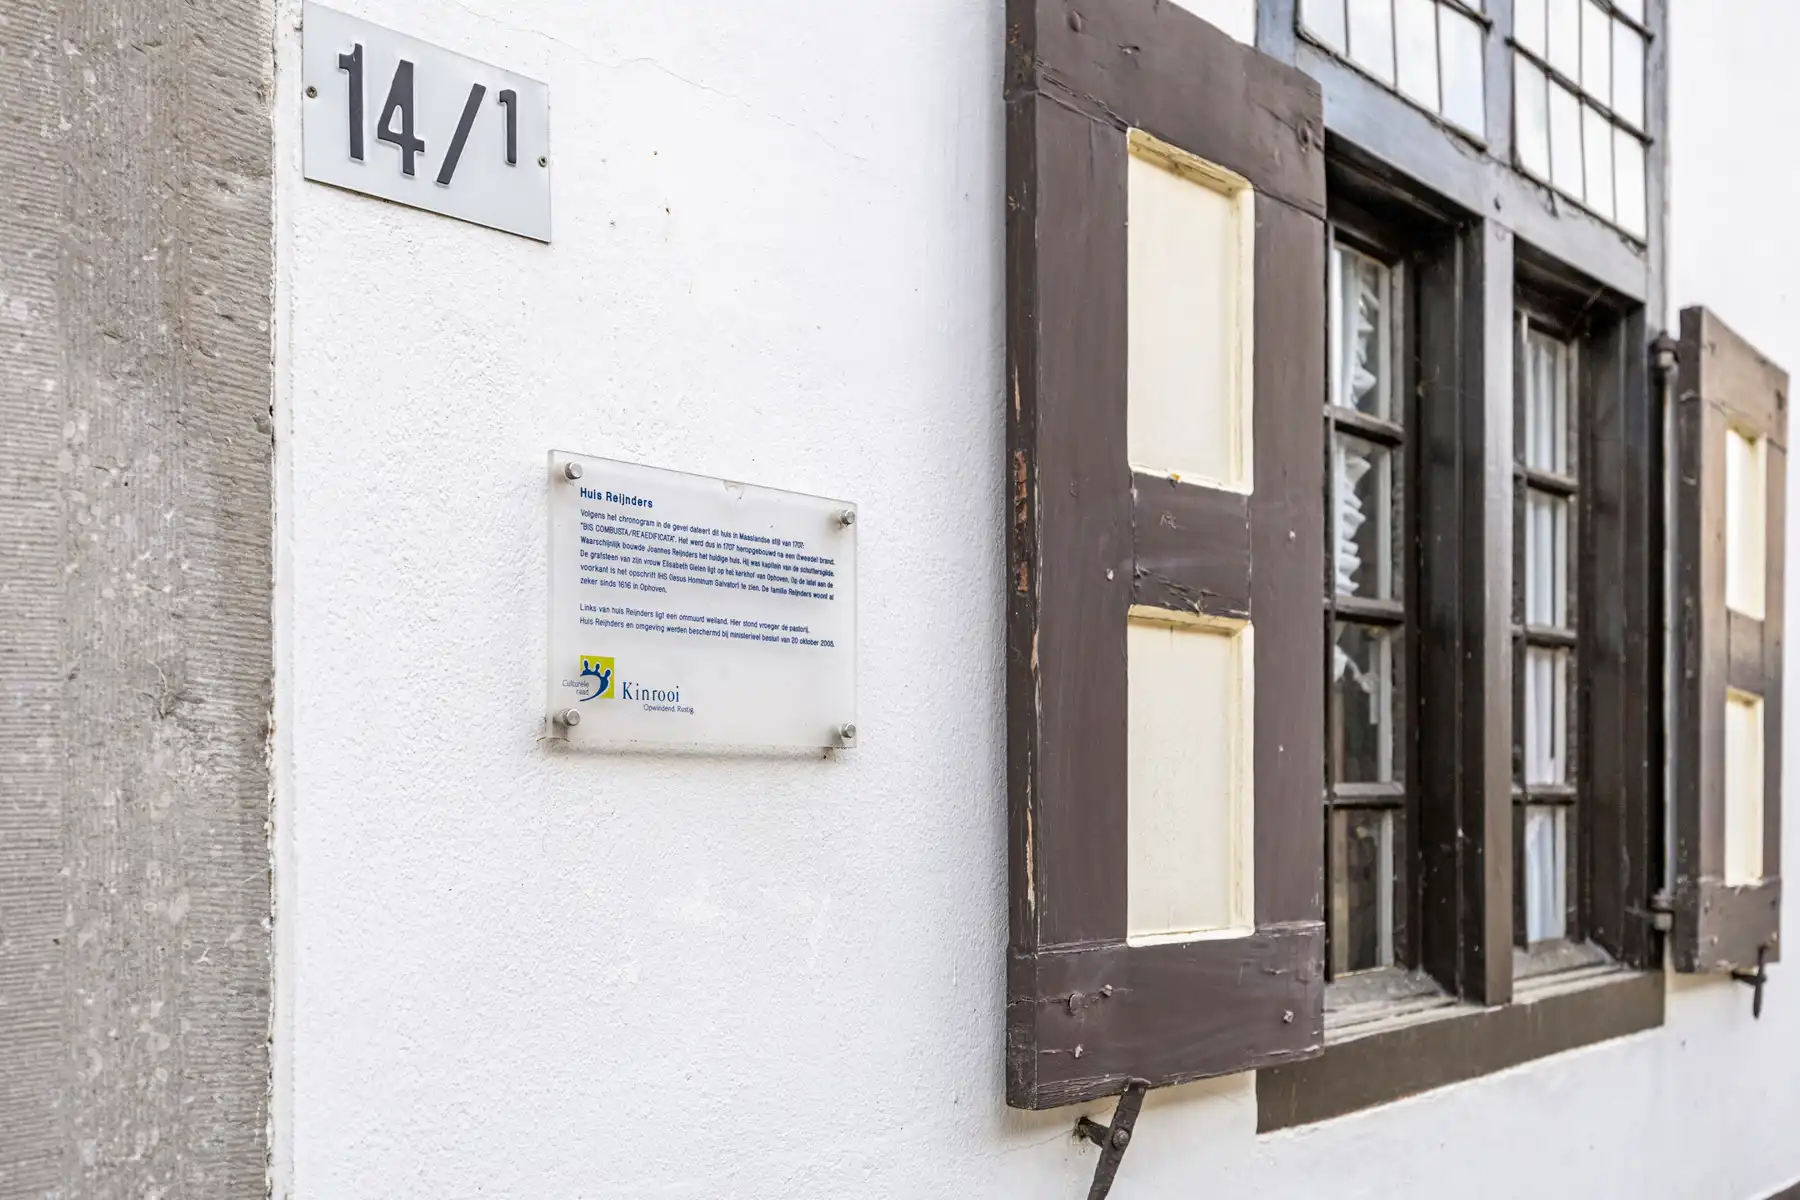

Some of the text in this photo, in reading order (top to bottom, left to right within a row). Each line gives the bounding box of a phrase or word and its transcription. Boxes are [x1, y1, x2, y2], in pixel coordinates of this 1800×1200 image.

[338, 42, 517, 185] 14/1
[580, 486, 653, 508] Huis Reijnders
[580, 508, 605, 520] Volgens
[607, 513, 617, 521] het
[618, 515, 655, 527] chronogram
[656, 520, 662, 528] in
[663, 521, 671, 529] de
[672, 524, 688, 532] gevel
[690, 526, 710, 535] dateert
[720, 530, 732, 538] huis
[739, 532, 770, 544] Maaslandse
[580, 536, 621, 549] Waarschijnlijk
[622, 541, 646, 552] bouwde
[647, 545, 671, 555] Joannes
[672, 548, 698, 559] Reijnders
[699, 552, 708, 560] het
[709, 553, 728, 564] huidige
[729, 556, 741, 564] huis.
[742, 557, 750, 566] Hij
[761, 561, 781, 570] kapitein
[678, 536, 688, 545] Het
[705, 540, 715, 549] dus
[723, 542, 735, 551] 1707
[736, 545, 776, 557] heropgebouwd
[580, 549, 588, 558] De
[590, 551, 619, 561] grafsteen
[632, 556, 642, 564] zijn
[662, 559, 688, 570] Elisabeth
[707, 565, 716, 575] ligt
[725, 568, 734, 576] het
[735, 569, 755, 578] kerkhof
[791, 576, 798, 585] Op
[798, 577, 805, 585] de
[827, 581, 834, 589] de
[580, 564, 608, 573] voorkant
[610, 566, 616, 574] is
[629, 570, 656, 579] opschrift
[657, 572, 668, 580] IHS
[688, 576, 714, 586] Hominum
[741, 582, 747, 590] te
[788, 588, 812, 598] Reijnders
[580, 577, 598, 585] zeker
[600, 579, 616, 588] sinds
[618, 580, 631, 589] 1616
[633, 582, 638, 590] in
[580, 603, 597, 612] Links
[612, 607, 624, 615] huis
[626, 607, 654, 618] Reijnders
[655, 611, 665, 620] ligt
[679, 614, 705, 623] ommuurd
[730, 618, 741, 626] Hier
[743, 620, 758, 628] stond
[759, 623, 780, 631] vroeger
[580, 617, 594, 625] Huis
[595, 617, 624, 628] Reijnders
[635, 623, 665, 633] omgeving
[666, 626, 687, 634] werden
[689, 627, 721, 637] beschermd
[730, 632, 761, 641] ministerieel
[762, 634, 779, 642] besluit
[791, 636, 799, 644] 20
[799, 638, 819, 646] oktober
[562, 680, 590, 688] Culturele
[575, 688, 590, 696] raad
[622, 681, 680, 702] Kinrooi
